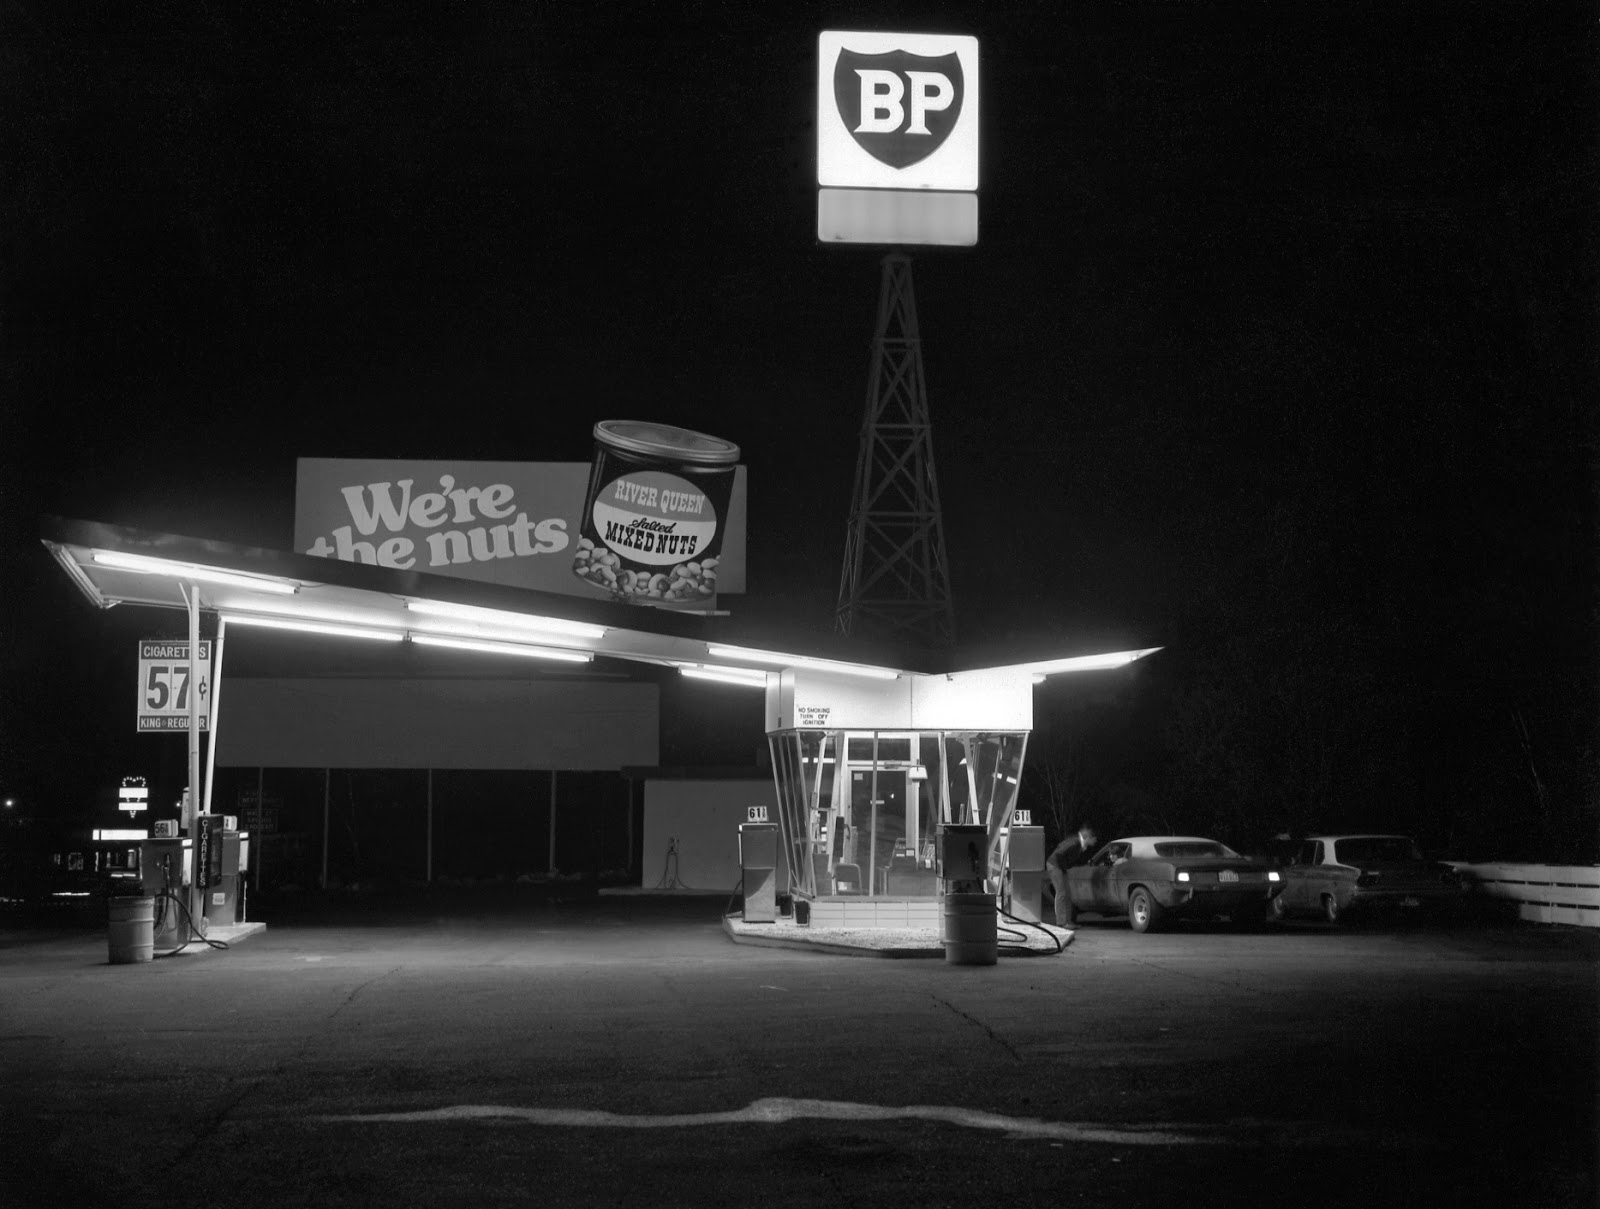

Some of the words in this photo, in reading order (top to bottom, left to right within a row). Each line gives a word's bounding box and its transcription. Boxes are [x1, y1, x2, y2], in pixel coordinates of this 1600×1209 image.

[853, 69, 955, 135] BP
[341, 474, 517, 536] We're
[614, 480, 658, 508] RIVER
[660, 489, 706, 514] QUEEN
[426, 512, 569, 567] nuts
[605, 520, 655, 552] MIXED
[656, 534, 698, 555] NUTS
[628, 517, 677, 534] Salted
[143, 646, 206, 658] CIGARETS
[140, 718, 160, 728] KING
[168, 717, 205, 728] REGUR
[200, 820, 209, 887] CIGARETTES
